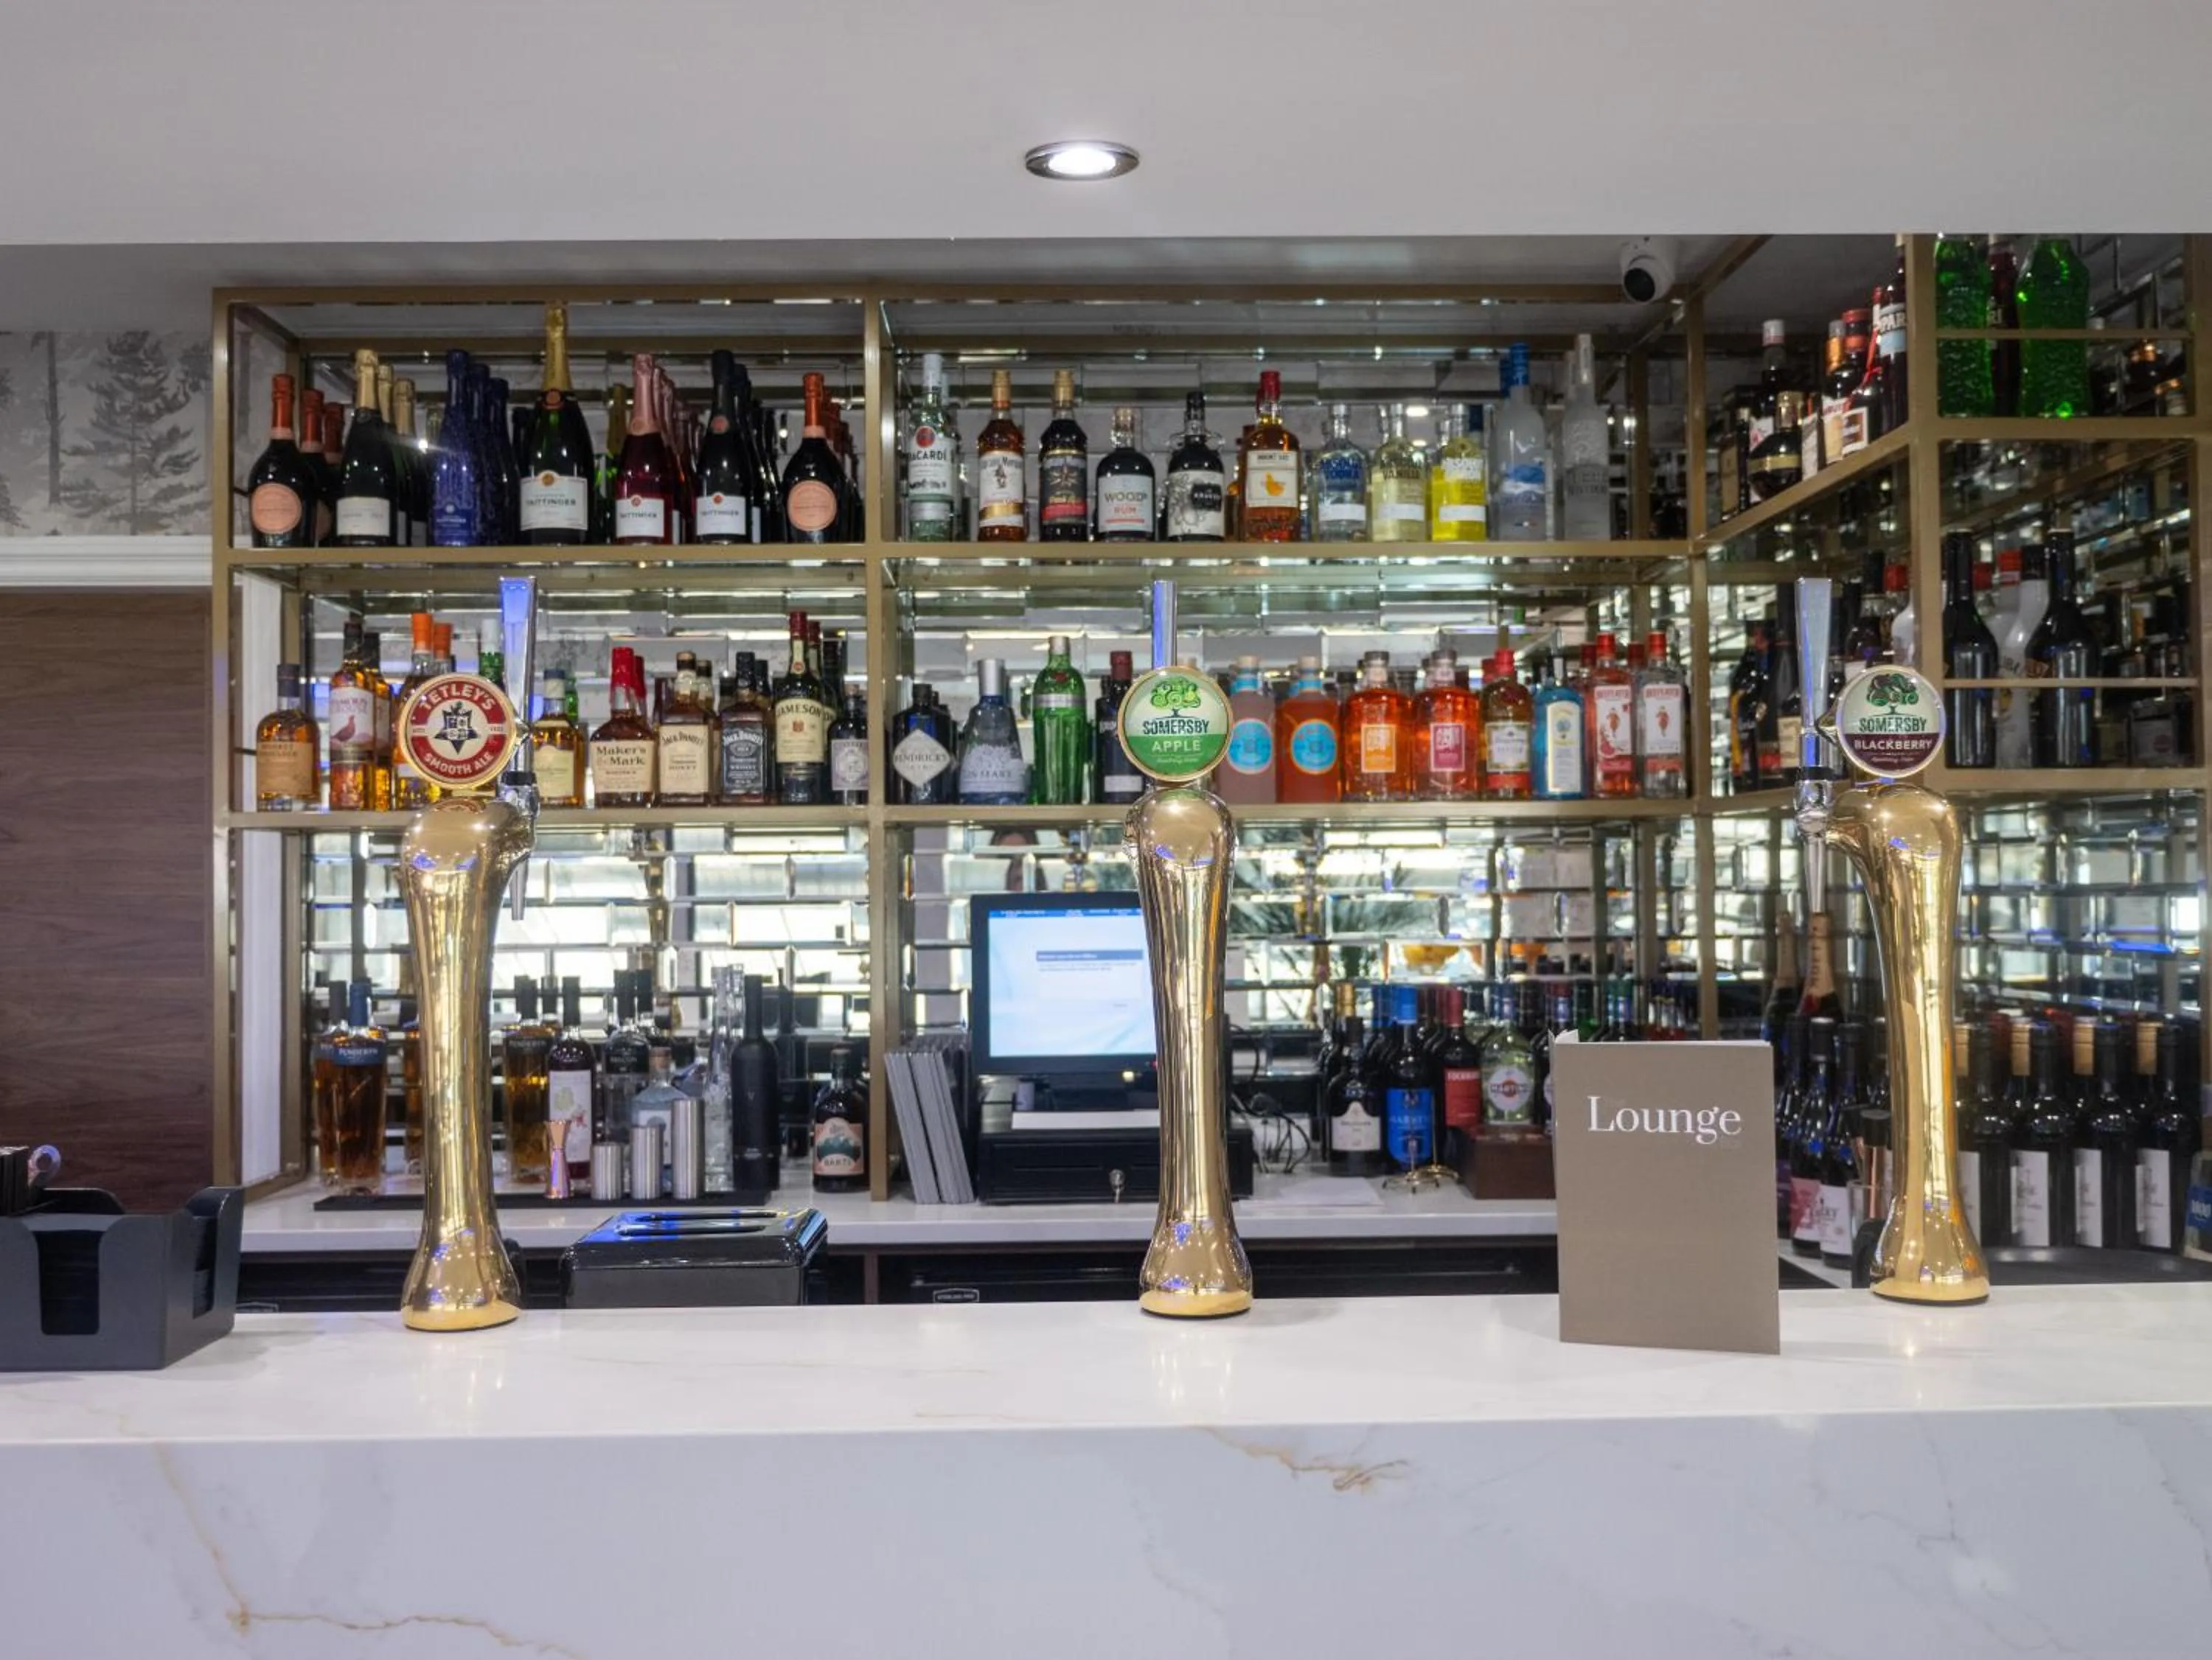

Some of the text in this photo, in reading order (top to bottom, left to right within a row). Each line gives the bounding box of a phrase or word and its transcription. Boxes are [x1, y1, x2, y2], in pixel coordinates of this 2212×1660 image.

[419, 683, 497, 710] TETLEY'S
[1142, 719, 1209, 735] SOMERSBY
[1858, 717, 1927, 733] SOMERSBY
[597, 745, 647, 756] Maker's
[1151, 739, 1201, 753] APPLE
[1854, 739, 1933, 750] BLACKBERRY
[424, 752, 493, 775] SMOOTH ALE
[610, 756, 646, 765] Mark
[1587, 1096, 1742, 1144] Lounge
